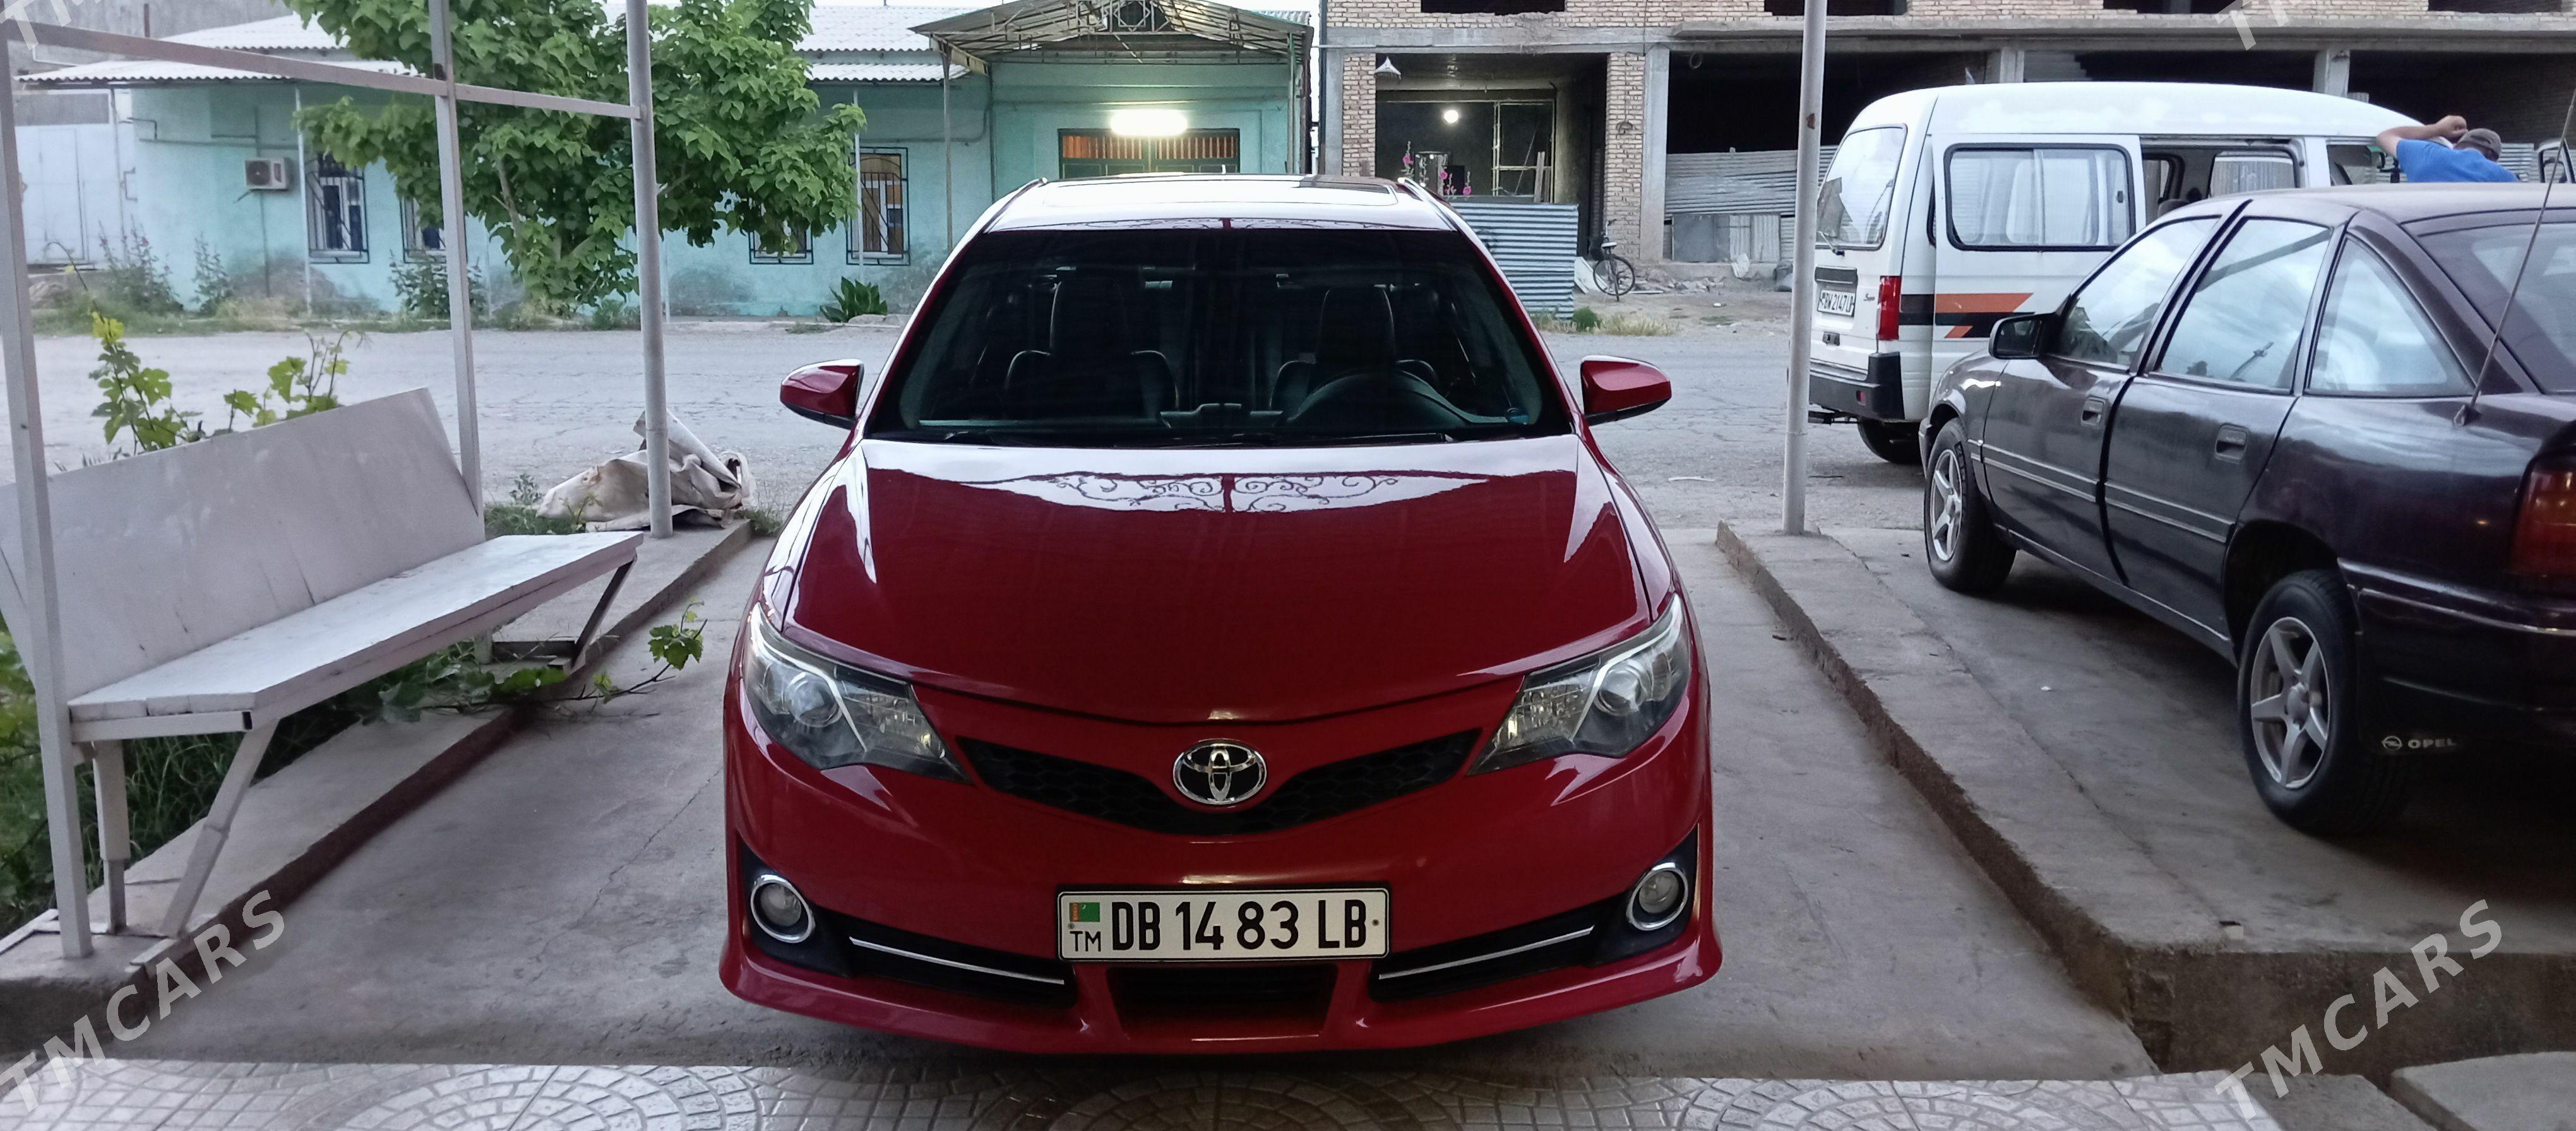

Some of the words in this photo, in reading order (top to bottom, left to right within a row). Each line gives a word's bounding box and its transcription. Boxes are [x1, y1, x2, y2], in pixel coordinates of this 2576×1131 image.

[2407, 738, 2457, 749] OPEL
[1111, 901, 1160, 950] DB
[1175, 901, 1224, 950] 14
[1236, 900, 1299, 950] 83
[1318, 899, 1366, 949] LB
[1070, 931, 1101, 952] TM
